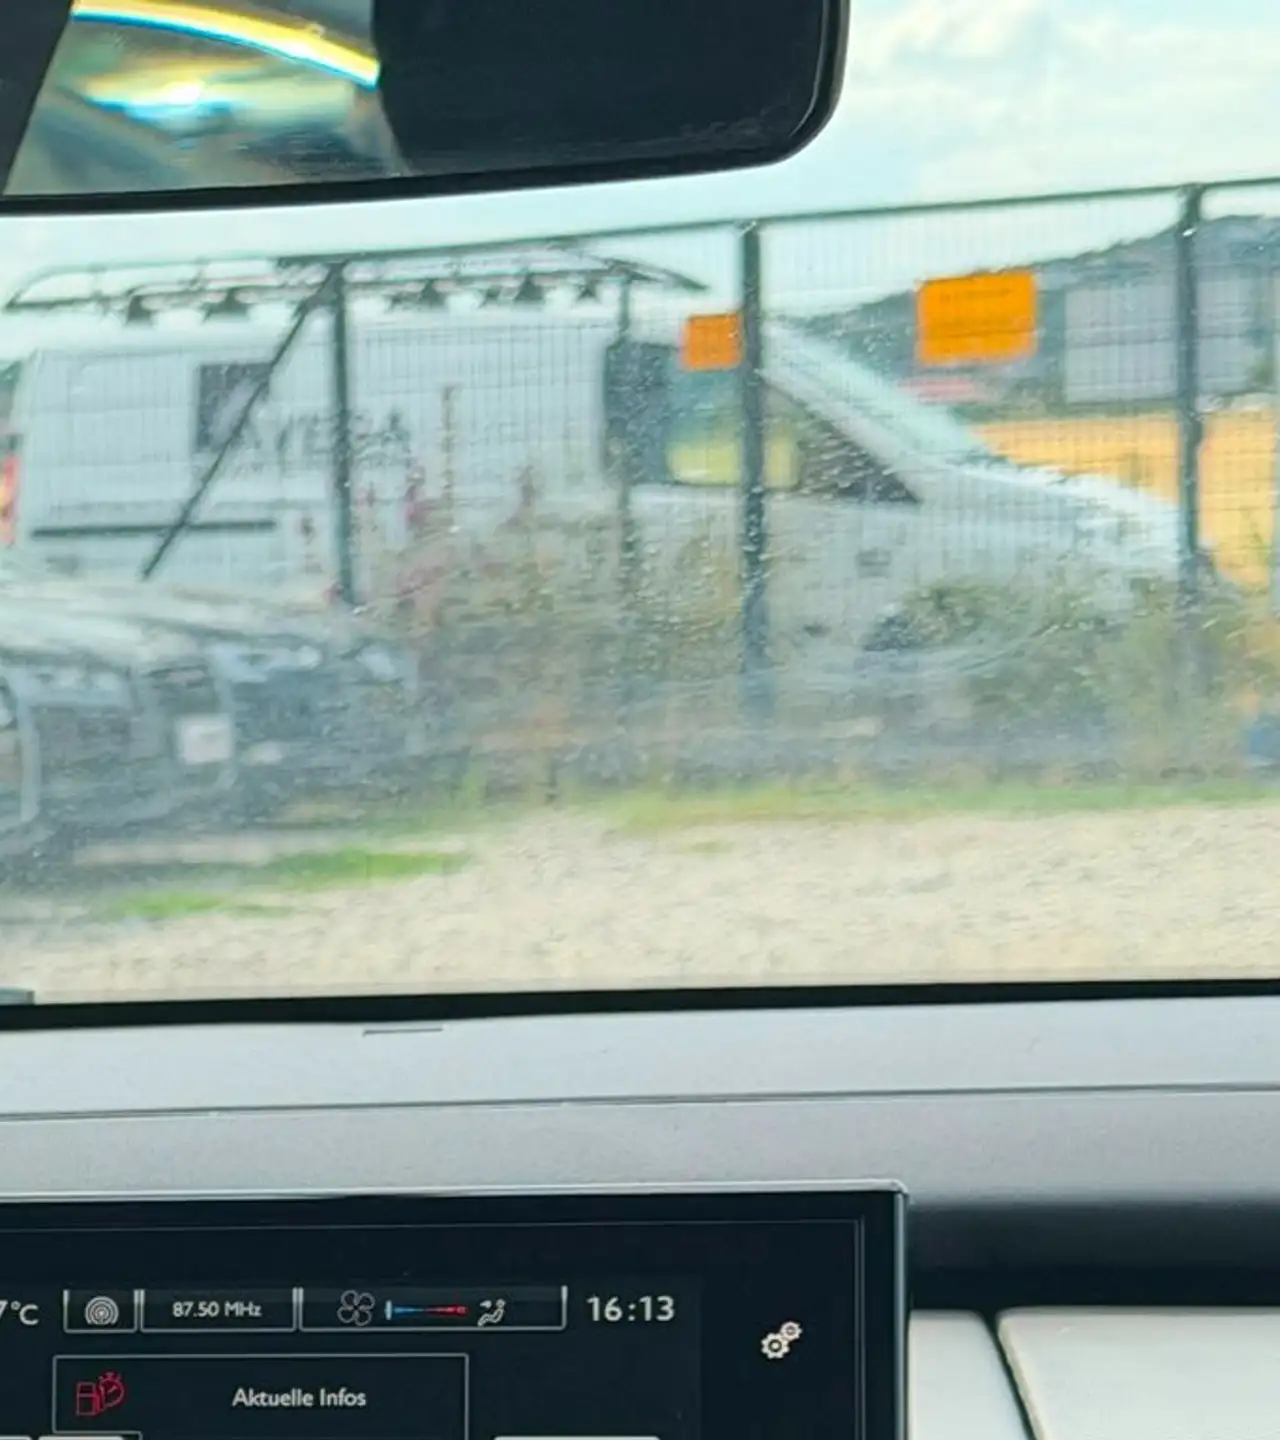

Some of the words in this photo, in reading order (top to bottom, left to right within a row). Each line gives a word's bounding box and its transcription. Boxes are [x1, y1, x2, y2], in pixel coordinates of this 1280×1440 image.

[172, 1301, 220, 1319] 87.50
[223, 1301, 263, 1319] MHz
[586, 1295, 676, 1323] 16:13
[231, 1386, 315, 1408] Aktuelle
[319, 1386, 368, 1408] Infos
